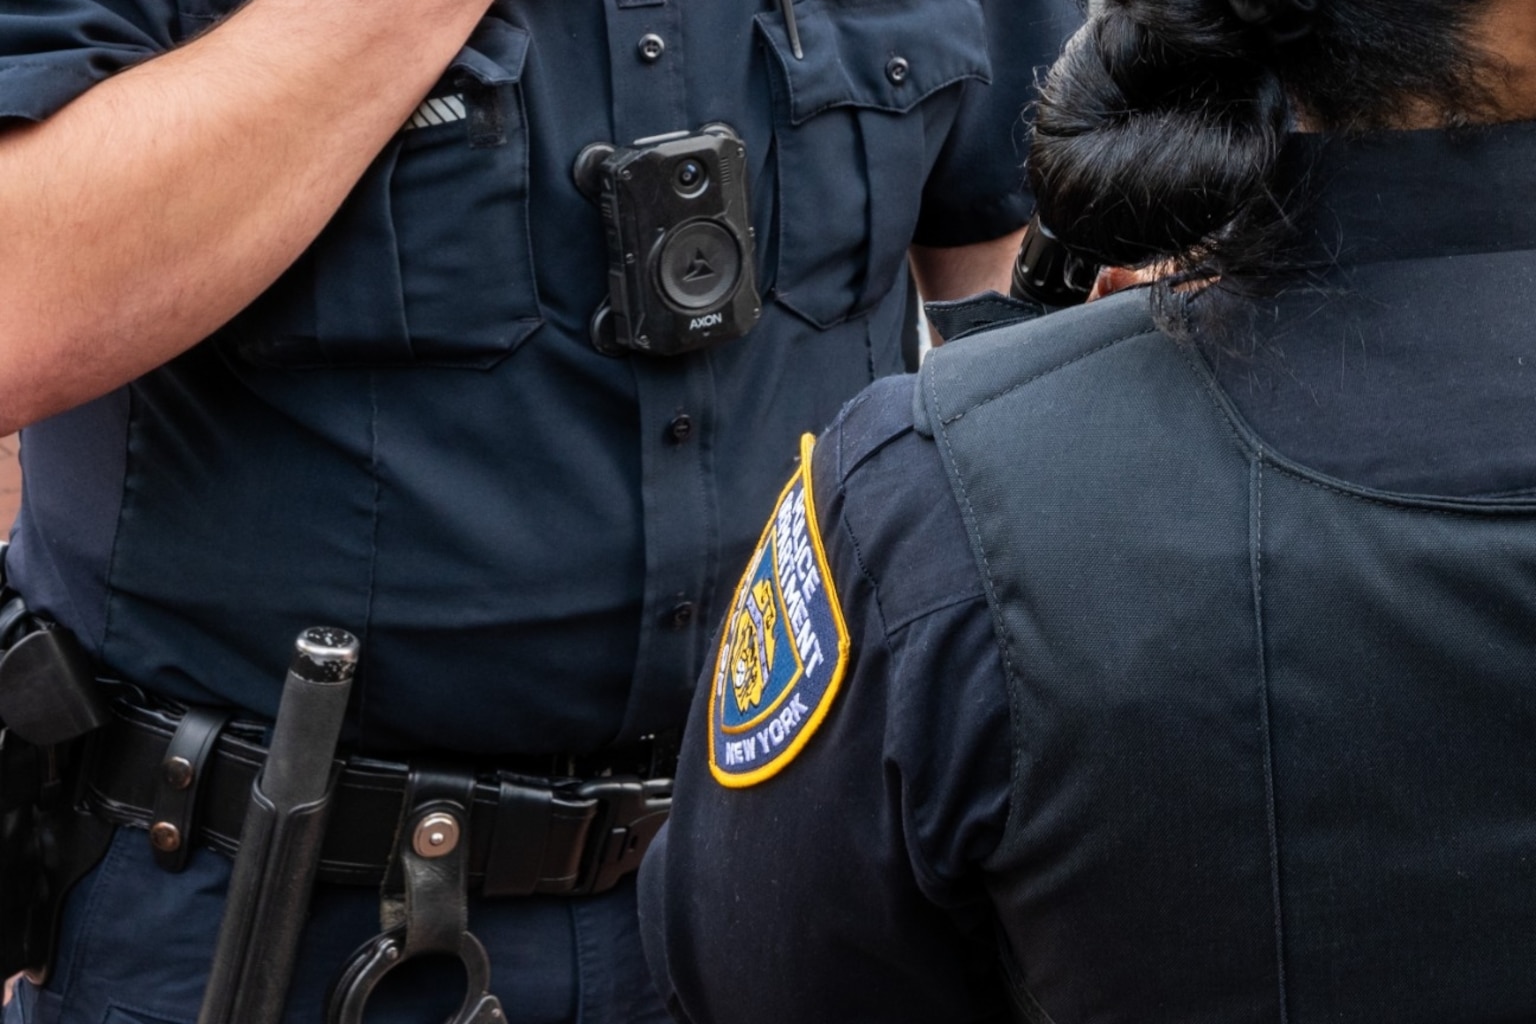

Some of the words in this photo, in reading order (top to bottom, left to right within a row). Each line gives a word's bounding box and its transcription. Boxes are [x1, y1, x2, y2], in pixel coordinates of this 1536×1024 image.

[689, 312, 722, 330] AXON
[776, 490, 825, 678] DEPARTMENT
[793, 487, 821, 605] POLICE
[725, 735, 756, 766] NEW
[755, 692, 809, 755] YORK
